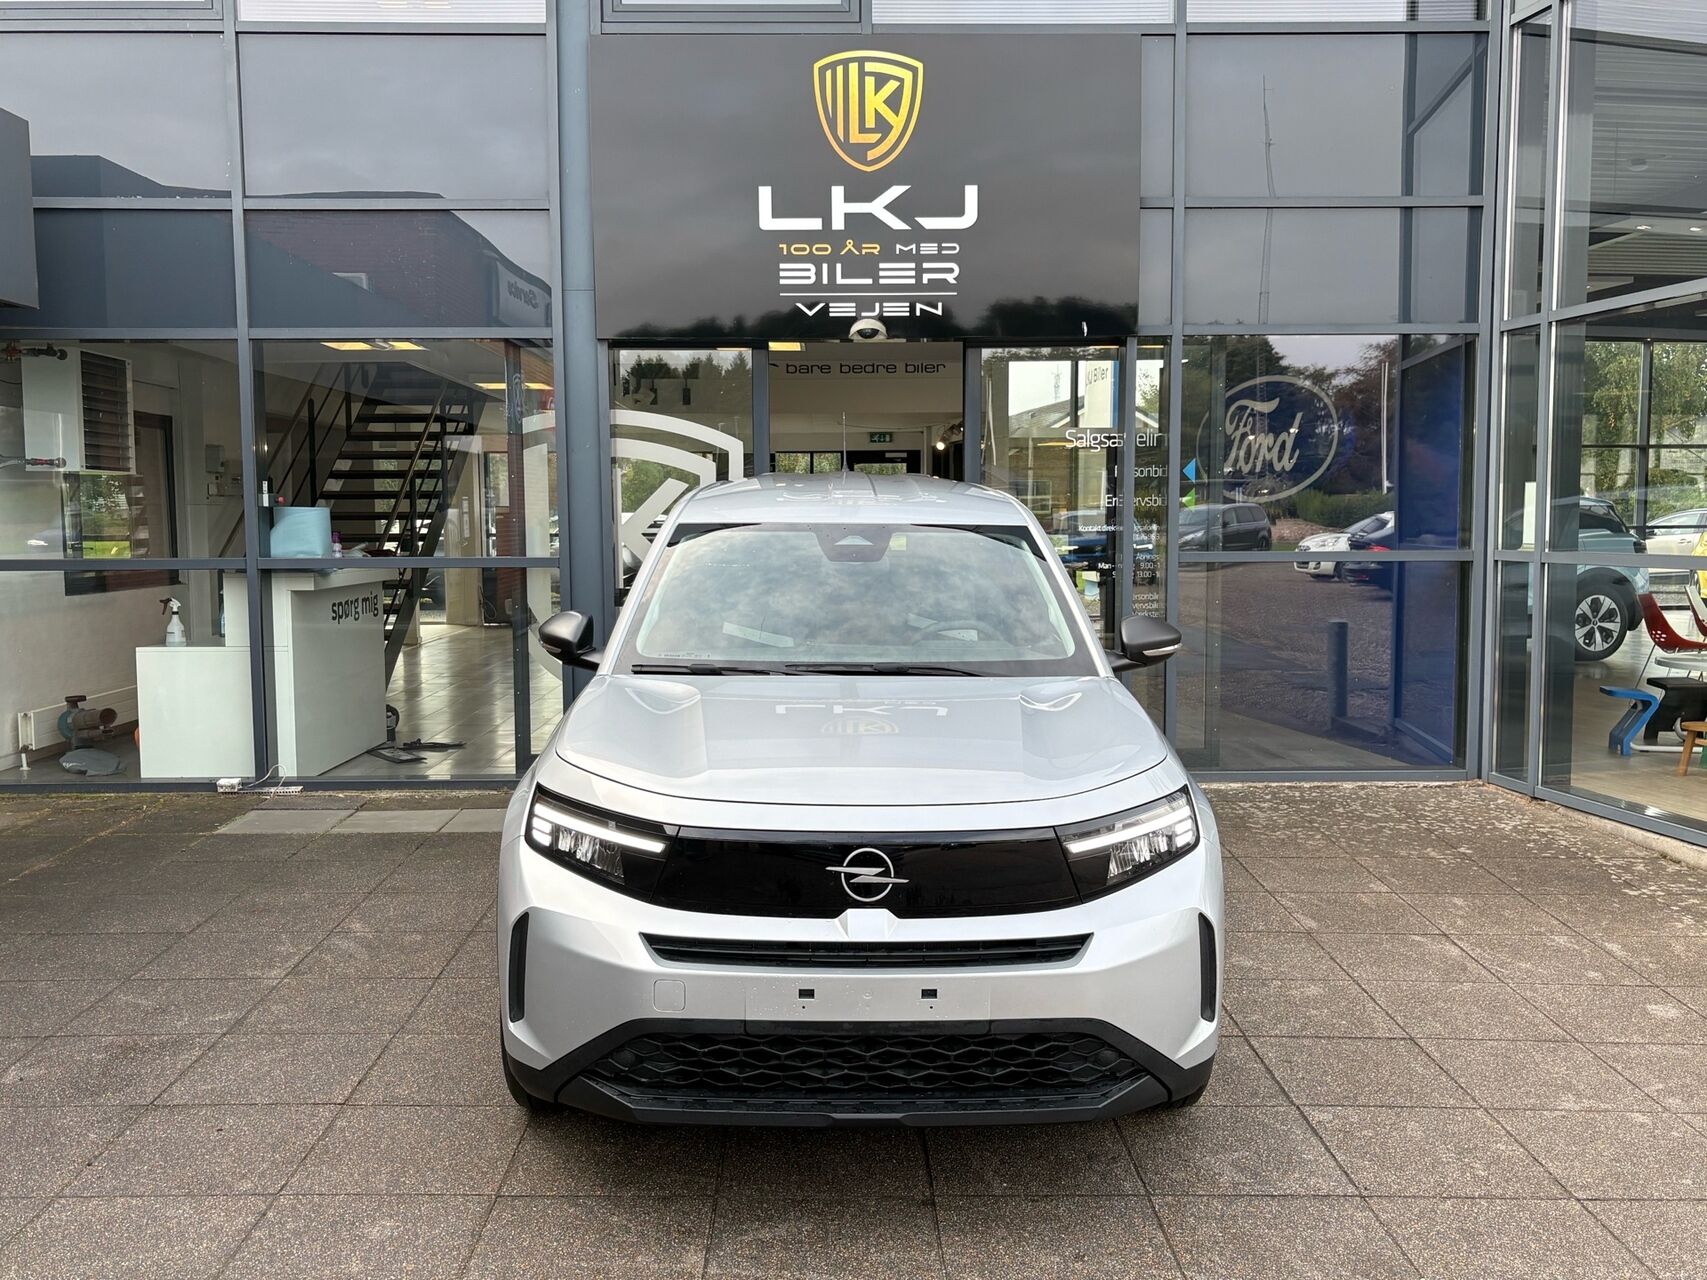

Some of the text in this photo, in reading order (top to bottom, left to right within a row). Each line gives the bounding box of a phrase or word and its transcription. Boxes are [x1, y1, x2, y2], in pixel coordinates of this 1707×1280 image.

[757, 184, 979, 231] LKJ
[778, 239, 960, 255] 100 ÅR MED
[778, 262, 960, 285] BILER
[794, 302, 943, 317] VEJEN
[785, 363, 946, 374] bare bedre biler
[1223, 397, 1304, 476] Ford
[331, 591, 379, 624] spørg mig
